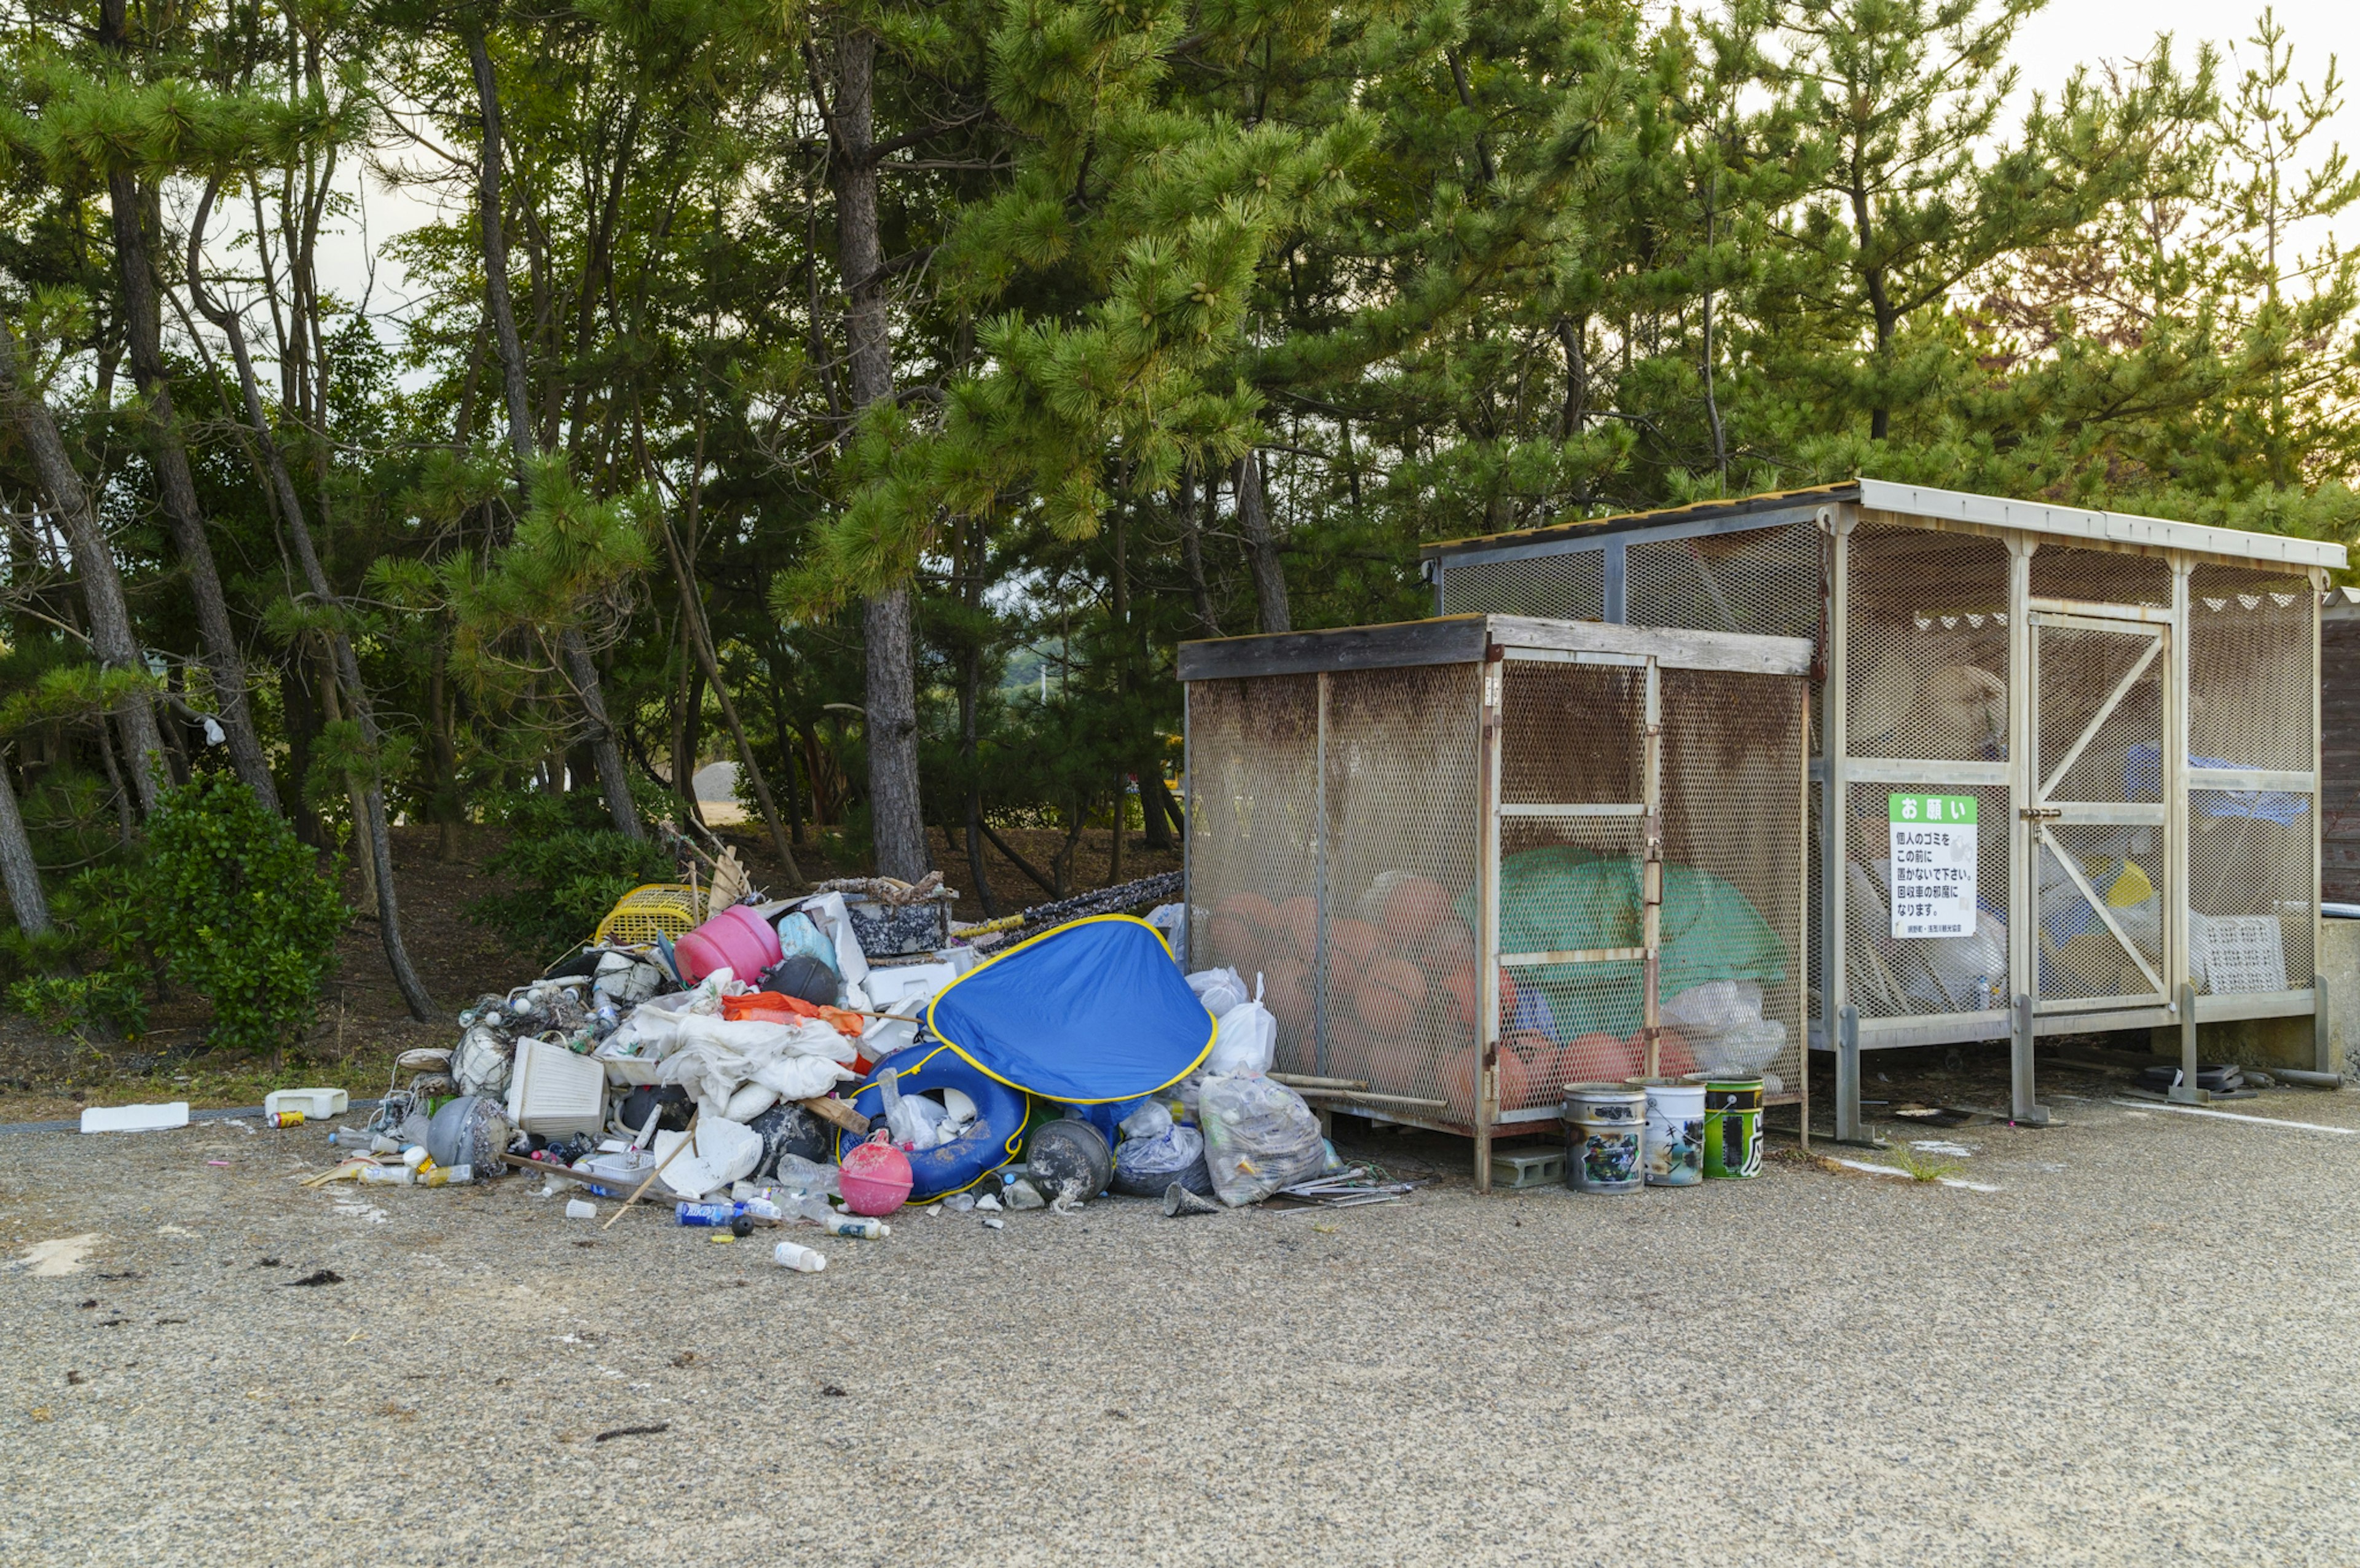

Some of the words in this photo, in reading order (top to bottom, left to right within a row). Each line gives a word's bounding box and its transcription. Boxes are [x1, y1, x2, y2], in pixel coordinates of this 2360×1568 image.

[1902, 798, 1965, 820] お願い
[1897, 831, 1950, 846] 個人のゴミを
[1897, 850, 1932, 863] この前に
[1897, 867, 1971, 881] 置かないで下さい。
[1897, 885, 1959, 899] 回収車の邪魔に
[1897, 903, 1938, 917] なります。
